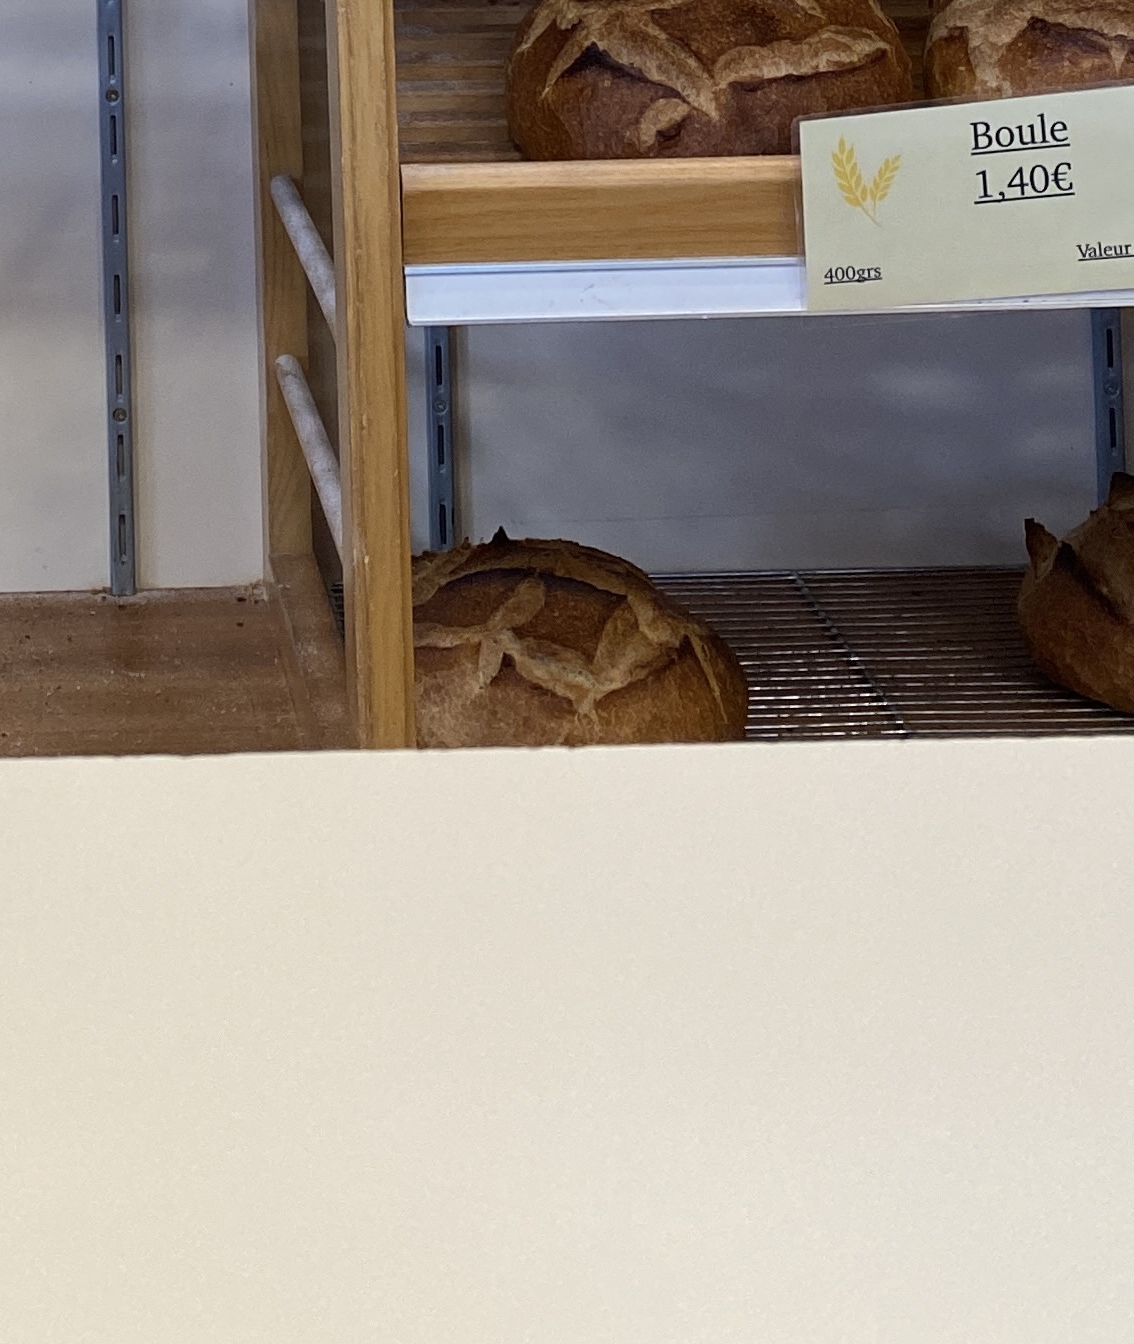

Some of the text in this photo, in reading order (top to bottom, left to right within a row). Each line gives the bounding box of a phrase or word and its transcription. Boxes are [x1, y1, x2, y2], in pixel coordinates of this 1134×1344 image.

[970, 113, 1070, 153] Boule
[975, 162, 1074, 201] 1,40€
[1076, 241, 1132, 259] Valeur
[824, 266, 882, 284] 400grs
